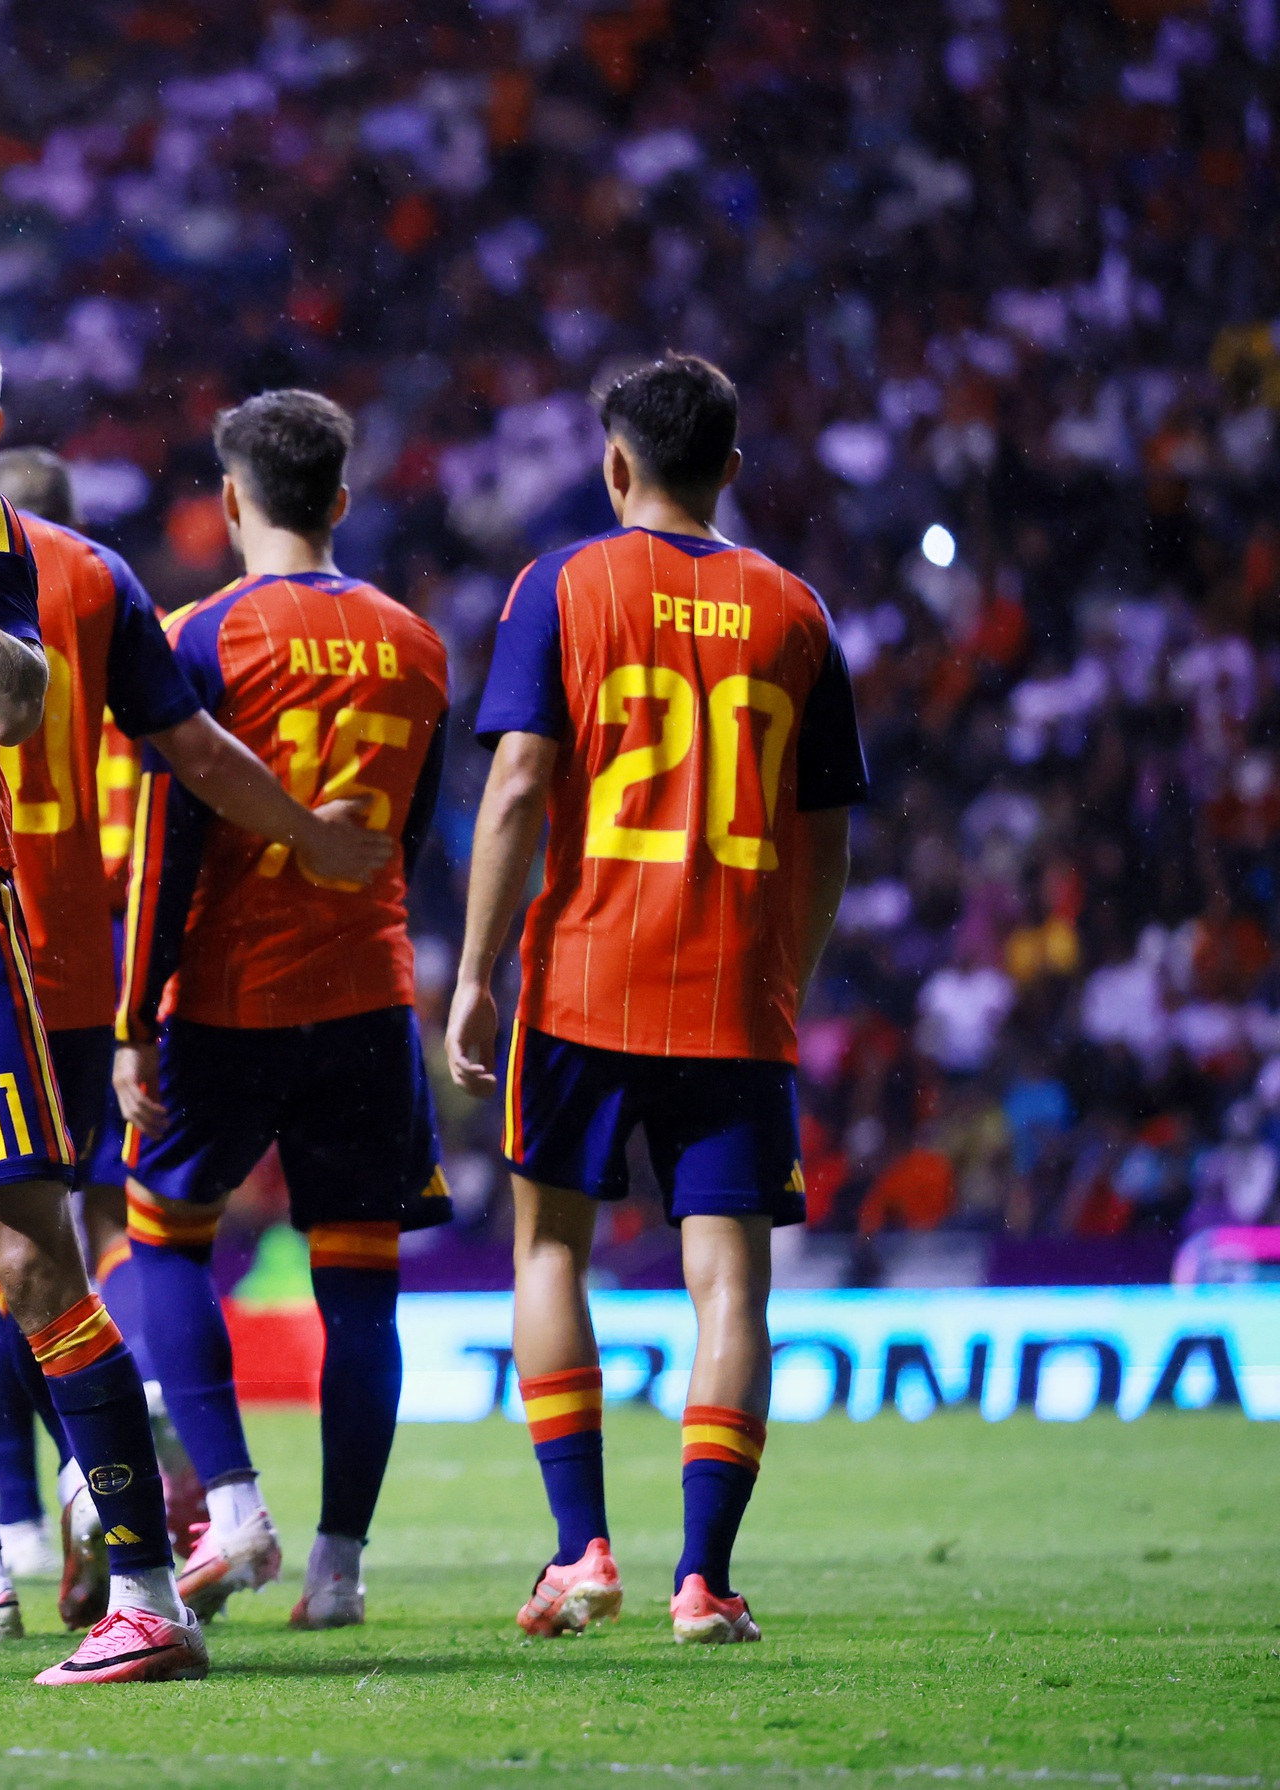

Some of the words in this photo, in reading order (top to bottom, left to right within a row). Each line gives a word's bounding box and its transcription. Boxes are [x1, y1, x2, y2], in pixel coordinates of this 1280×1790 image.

[651, 592, 751, 640] PEDRI
[289, 638, 369, 676] ALEX
[585, 664, 793, 871] 20
